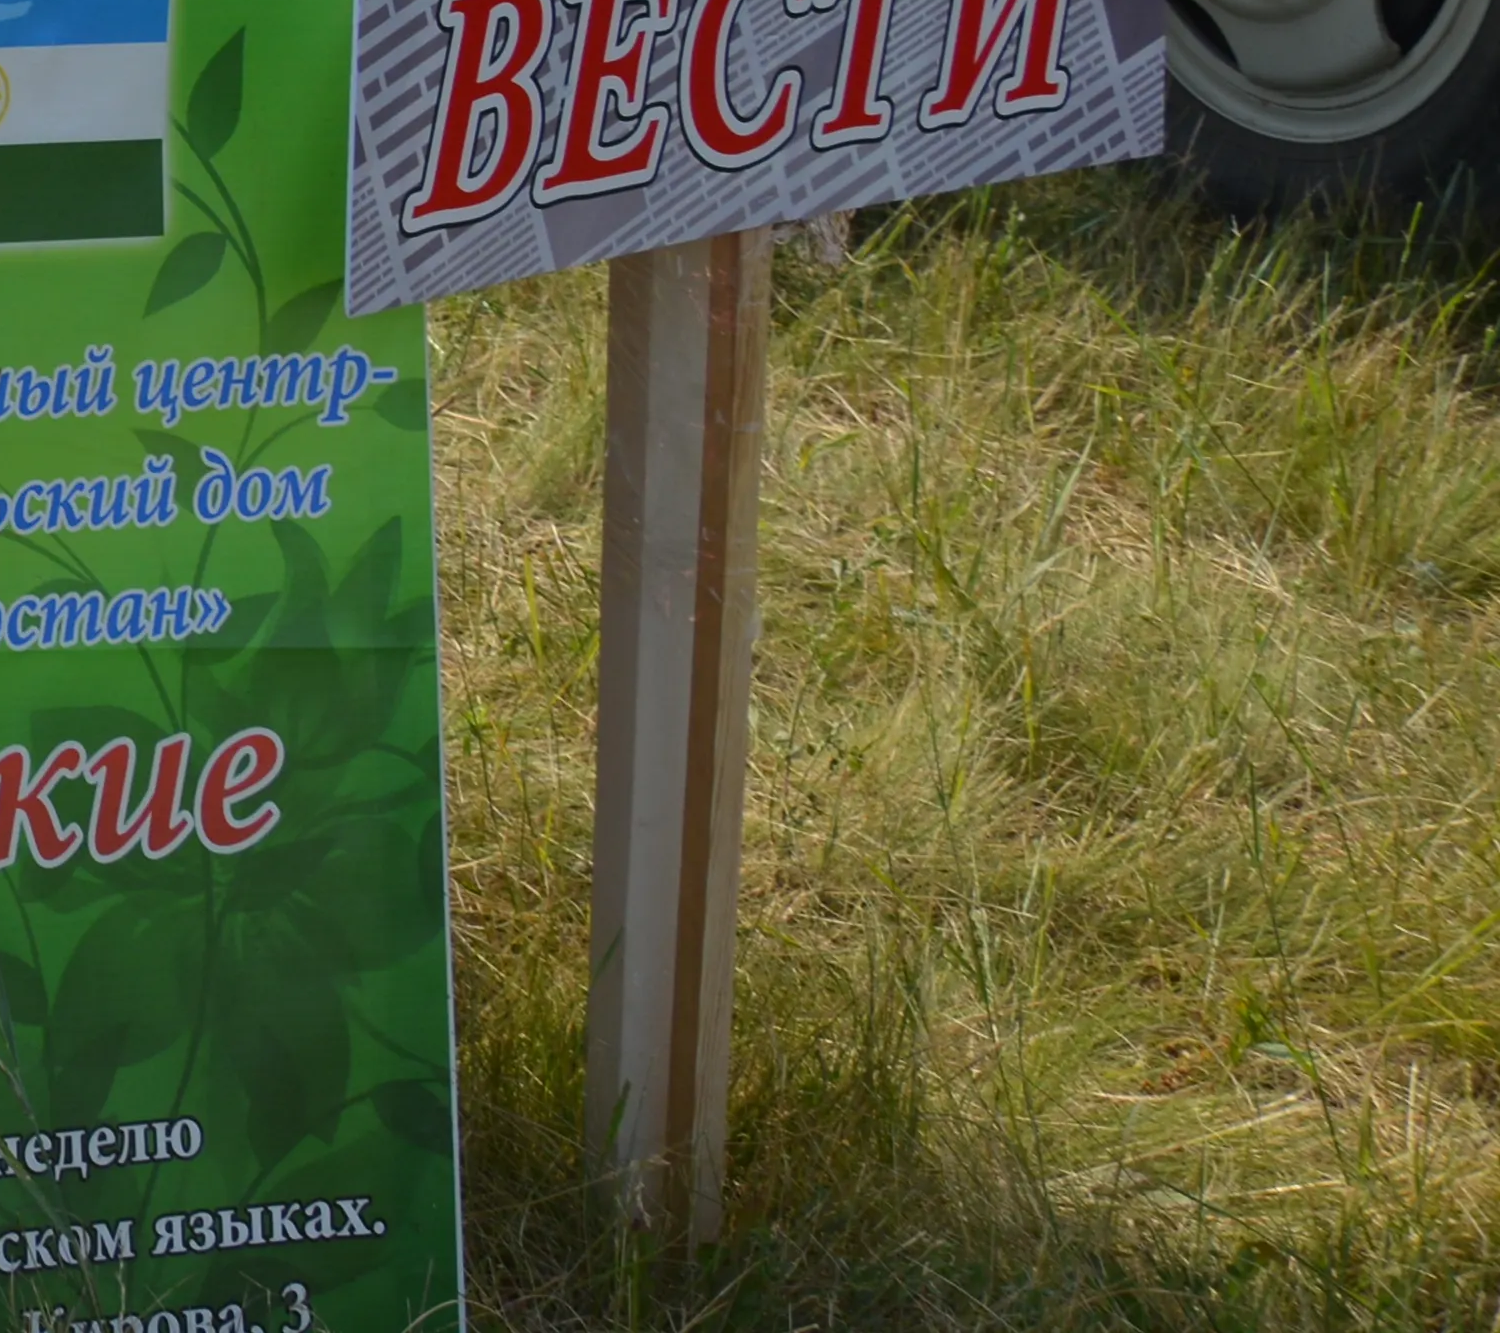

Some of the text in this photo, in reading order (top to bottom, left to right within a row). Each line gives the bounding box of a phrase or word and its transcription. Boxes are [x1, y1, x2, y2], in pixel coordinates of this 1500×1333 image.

[132, 345, 397, 426] центр-
[192, 447, 332, 524] дом
[151, 1194, 388, 1255] языках.
[280, 1281, 311, 1333] 3
